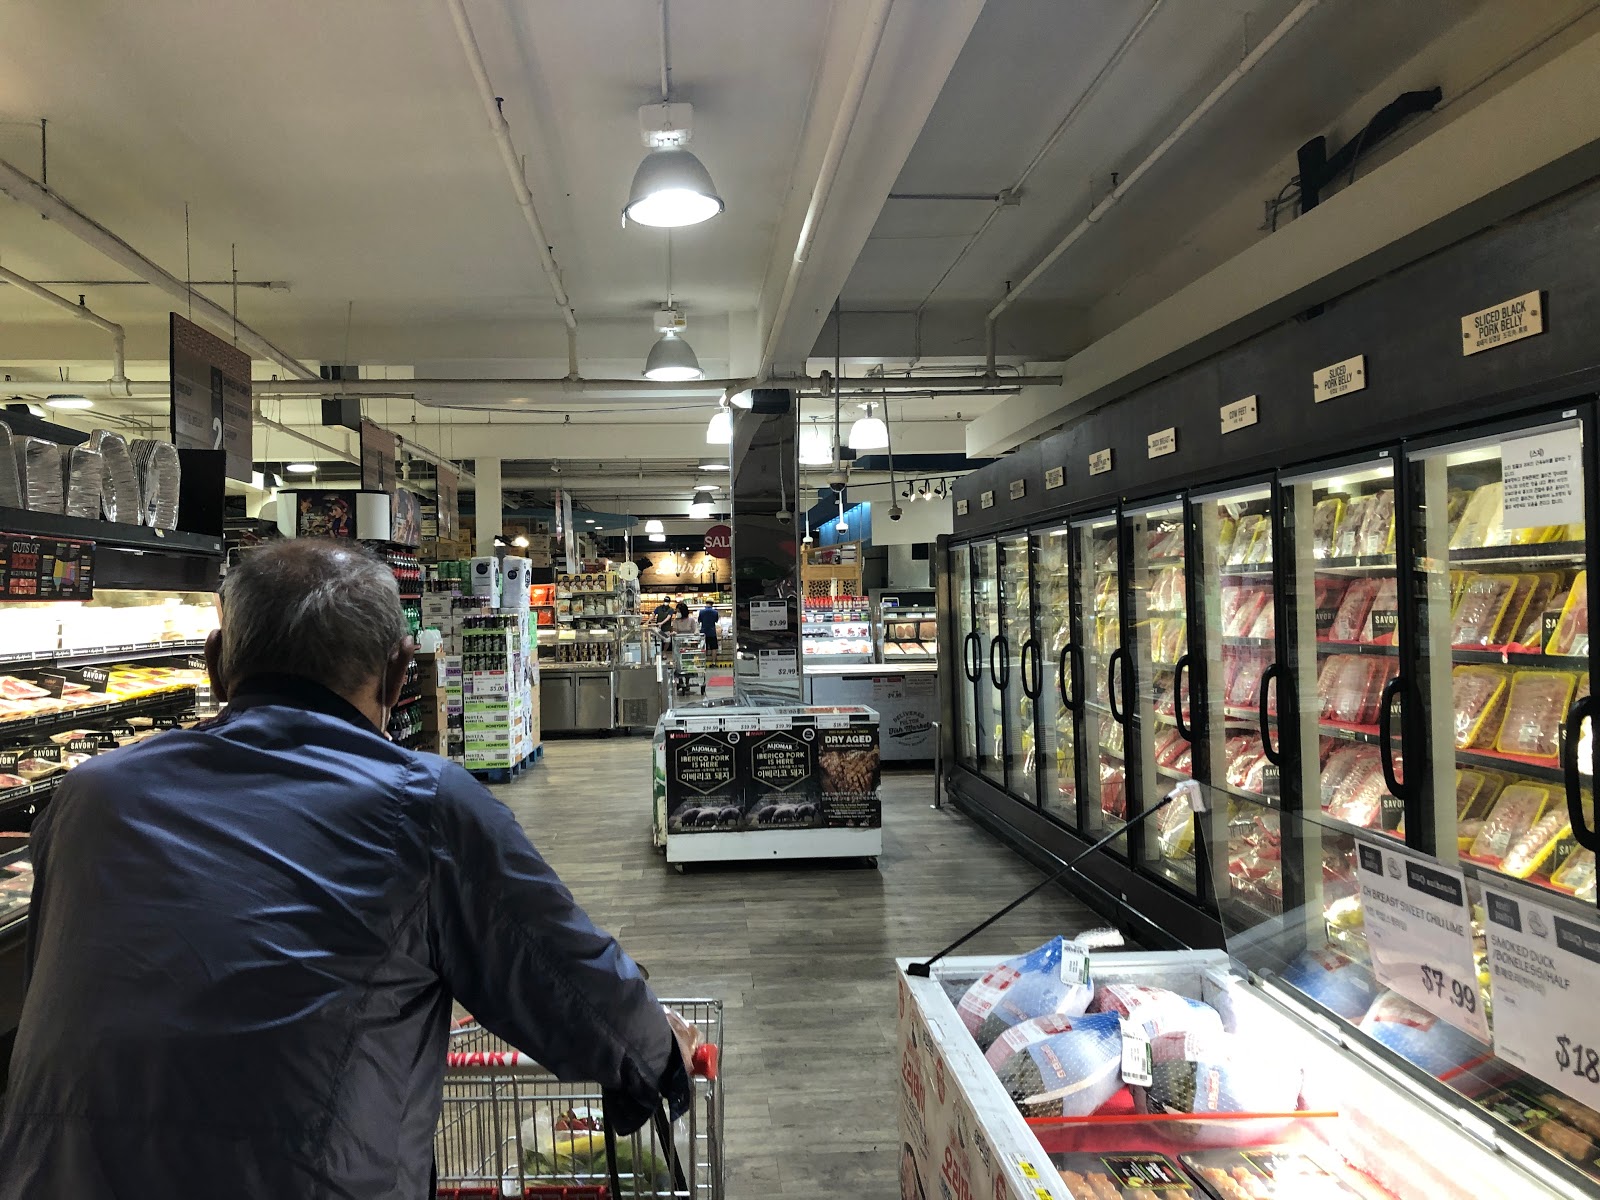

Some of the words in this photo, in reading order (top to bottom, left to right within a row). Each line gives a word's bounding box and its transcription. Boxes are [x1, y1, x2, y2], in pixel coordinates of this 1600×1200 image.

[1475, 310, 1500, 328] SLICED
[1502, 300, 1526, 318] BLACK
[1479, 322, 1499, 338] PORK
[1501, 314, 1522, 331] BELLY
[1329, 365, 1346, 378] SLICED
[1325, 378, 1337, 390] PORK
[1338, 372, 1352, 385] BELLY
[12, 542, 30, 553] CUTS
[1375, 615, 1398, 624] SAVOR
[83, 670, 106, 680] SAVORY
[825, 735, 844, 743] DRY
[846, 735, 872, 743] AGED
[681, 772, 711, 781] 이베리코
[715, 771, 729, 780] 돼지
[757, 770, 787, 778] 이베리코
[790, 769, 804, 777] 돼지
[1384, 799, 1404, 808] SAVO
[1372, 889, 1398, 908] BREAST
[1400, 900, 1425, 919] SWEET
[1445, 920, 1464, 936] LIME
[1491, 934, 1528, 957] SMOKED
[1529, 950, 1556, 970] DUCK
[1421, 963, 1475, 1013] $7.99
[447, 1052, 519, 1067] MART
